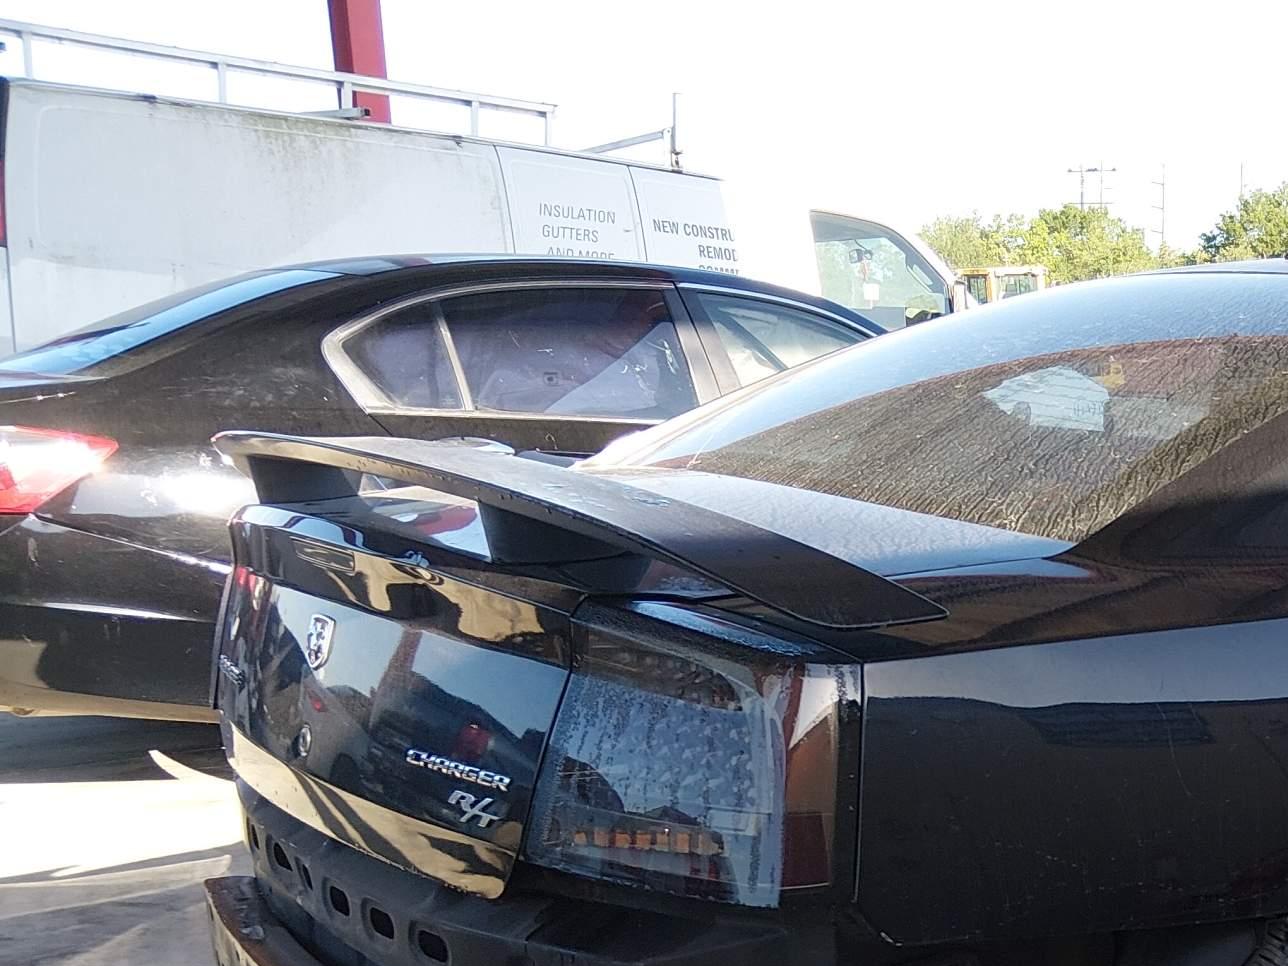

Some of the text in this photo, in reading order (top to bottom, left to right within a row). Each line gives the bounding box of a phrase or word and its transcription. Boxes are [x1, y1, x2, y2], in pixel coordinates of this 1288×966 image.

[539, 202, 616, 225] INSULATION
[542, 224, 599, 243] GUTTERS
[652, 218, 679, 236] NEW
[406, 749, 511, 792] CHARGER
